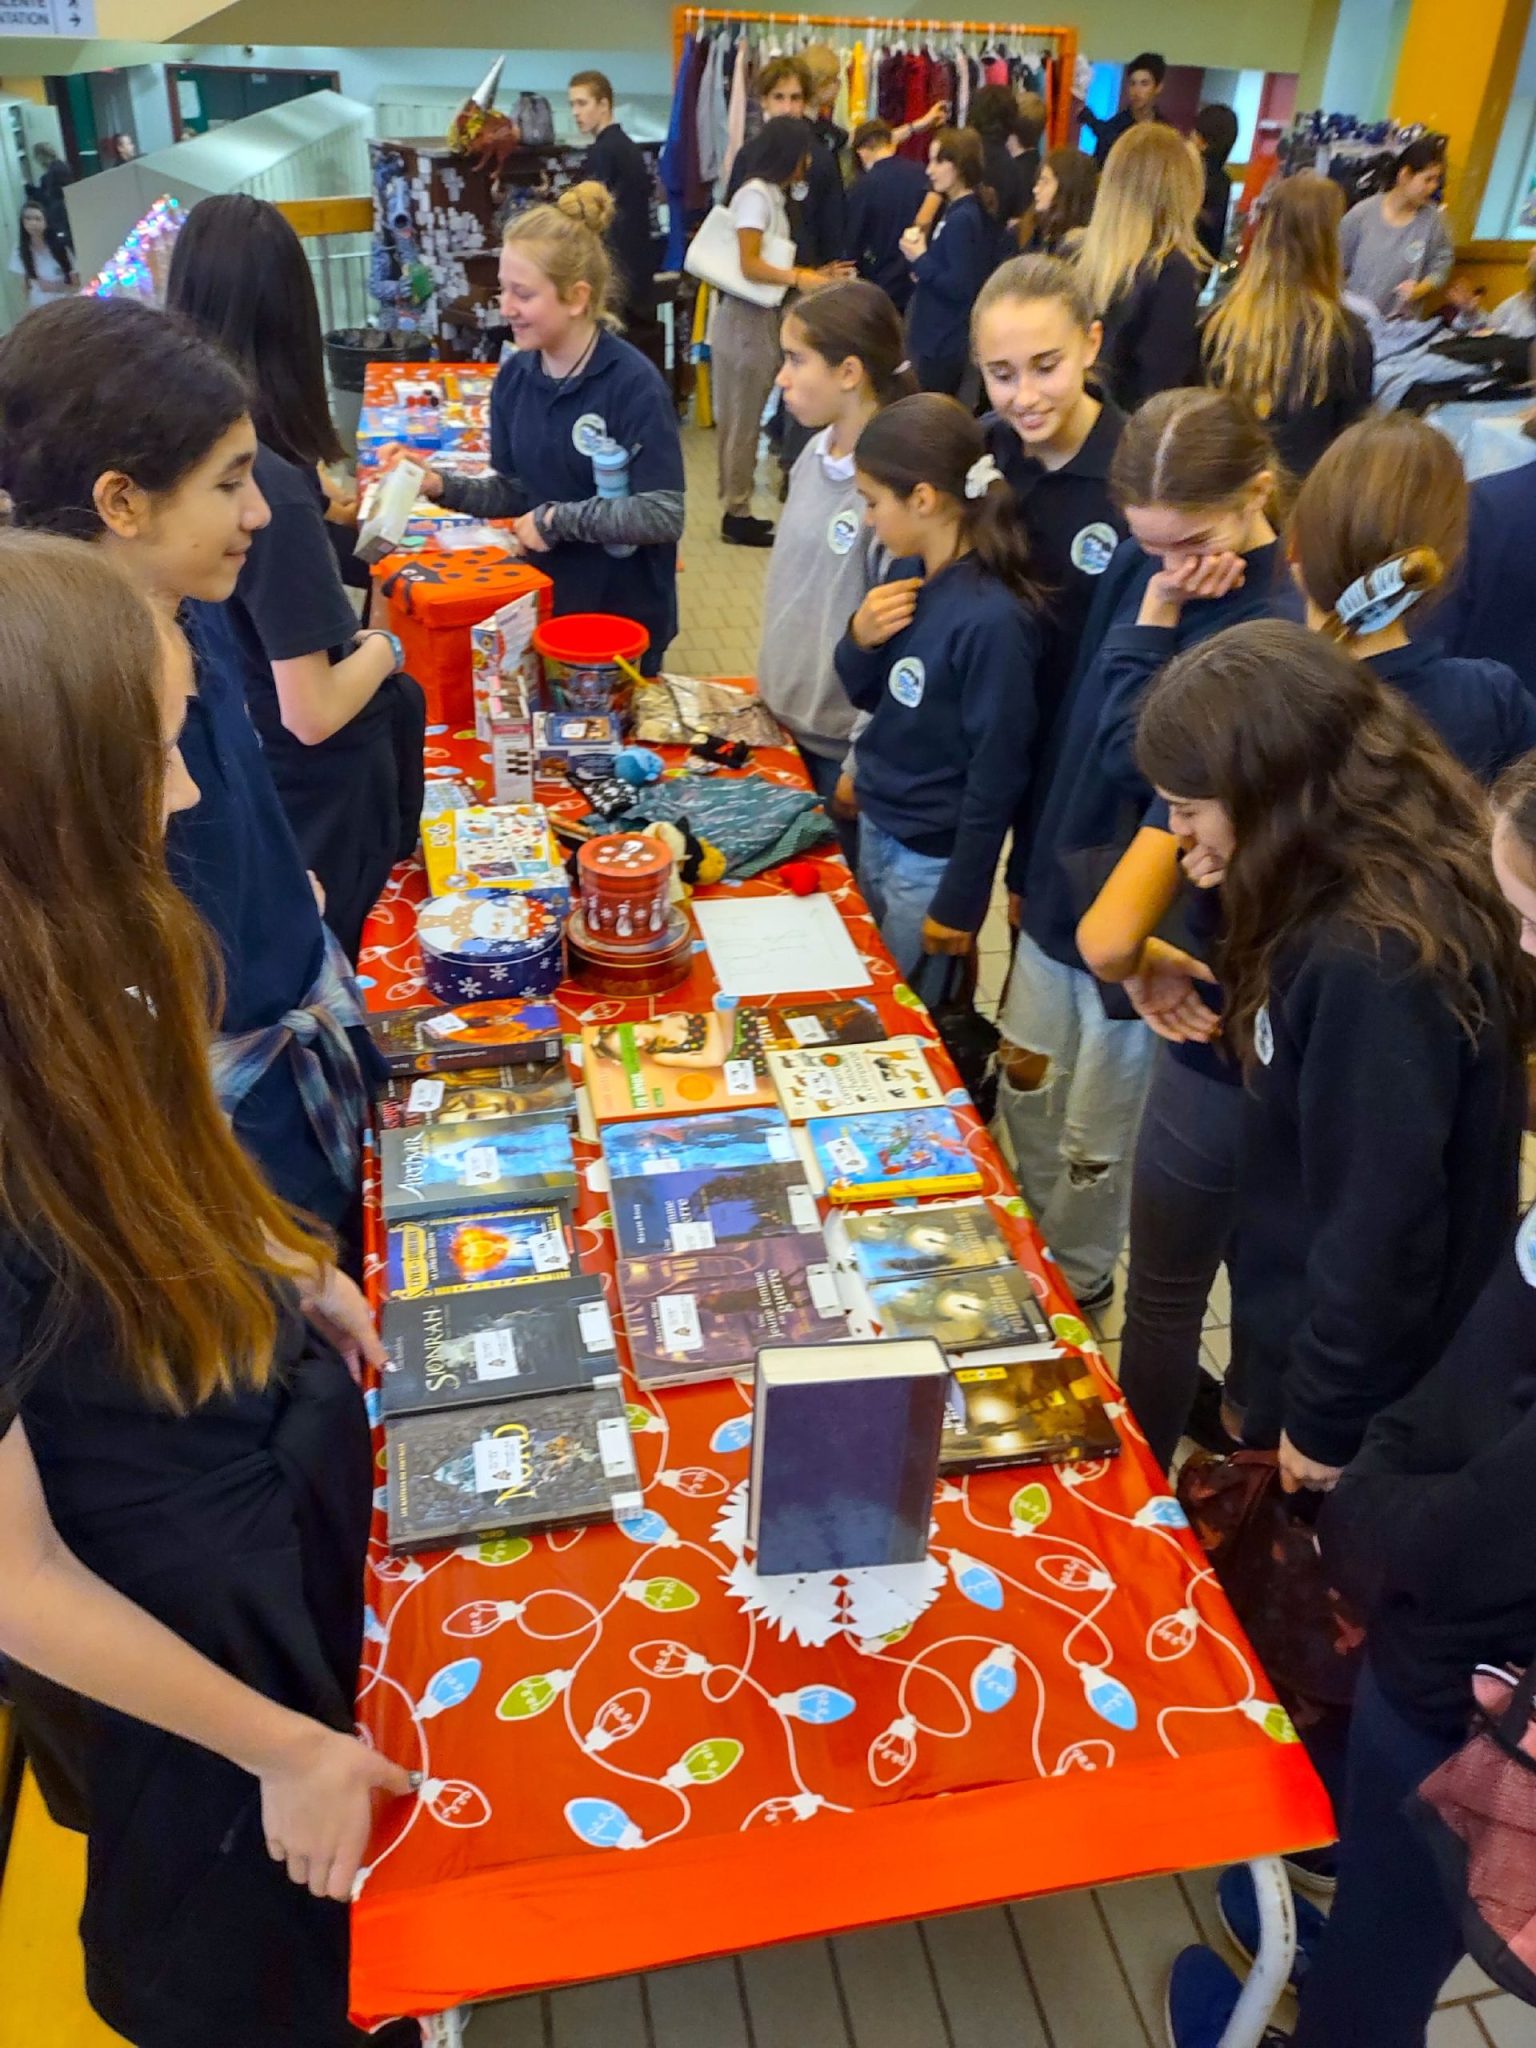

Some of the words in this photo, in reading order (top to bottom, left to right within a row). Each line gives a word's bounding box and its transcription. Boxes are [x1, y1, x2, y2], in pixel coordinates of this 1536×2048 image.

[678, 1198, 693, 1223] erre
[754, 1271, 772, 1307] femme
[767, 1268, 796, 1313] guerre
[764, 1309, 786, 1338] jeune
[424, 1306, 460, 1392] SIONRAH
